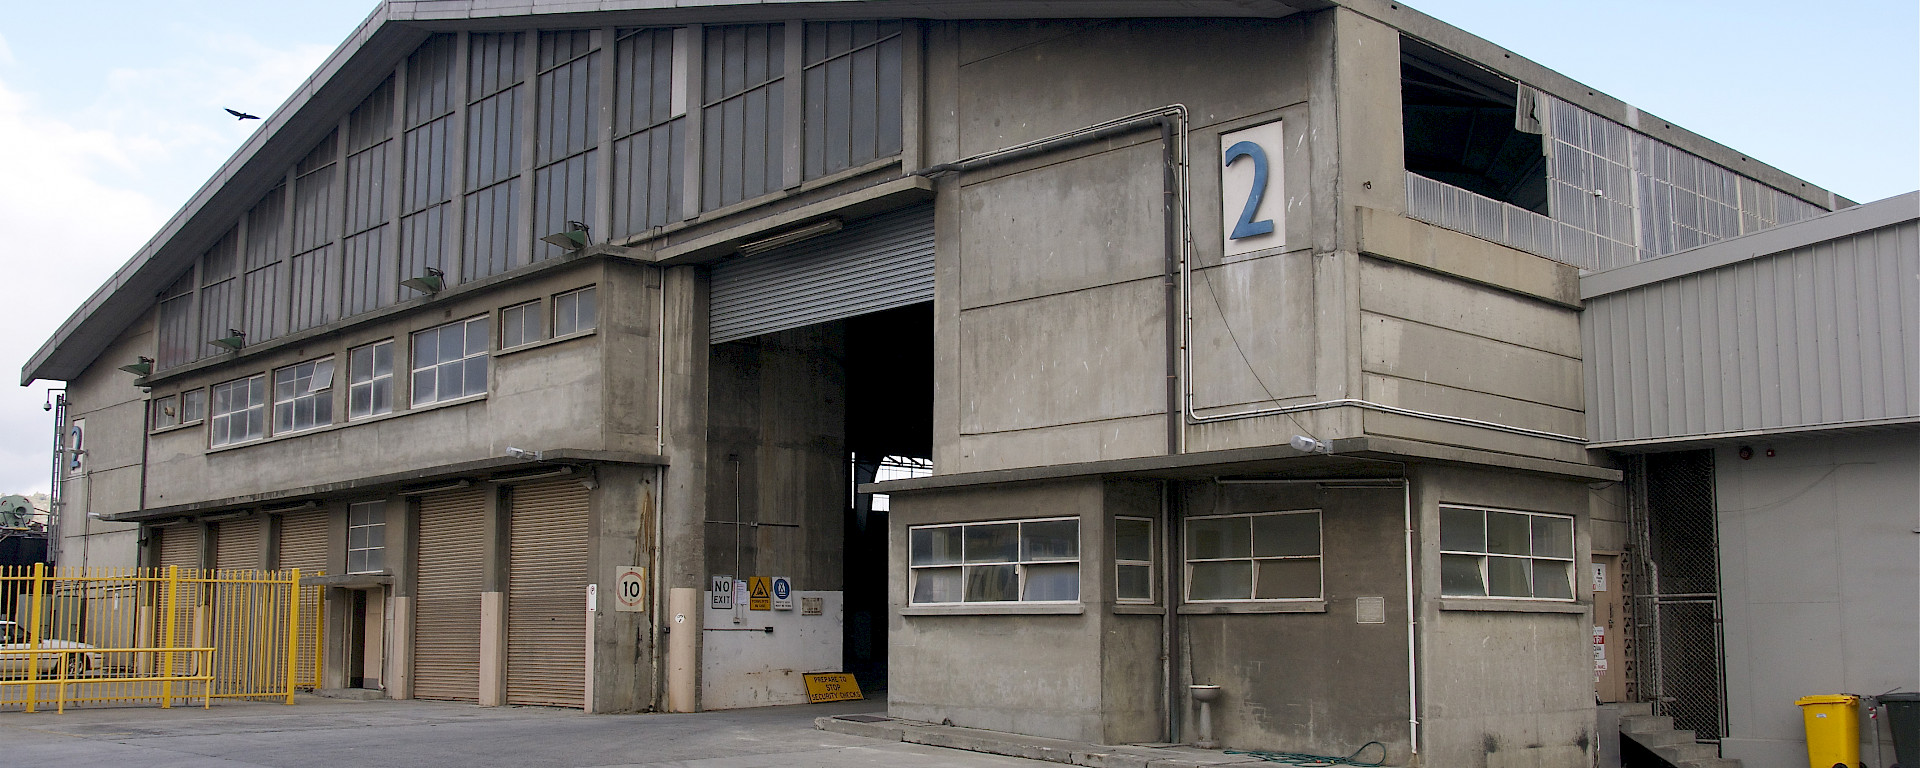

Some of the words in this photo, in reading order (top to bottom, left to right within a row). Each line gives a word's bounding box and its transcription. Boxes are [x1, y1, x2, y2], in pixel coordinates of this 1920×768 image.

[1225, 140, 1274, 240] 2
[70, 426, 82, 470] 2
[623, 581, 640, 597] 10
[714, 580, 730, 592] NO
[713, 595, 730, 604] EXIT
[825, 683, 841, 691] STOP
[811, 692, 838, 701] SECURITY
[839, 691, 861, 699] CHECKS
